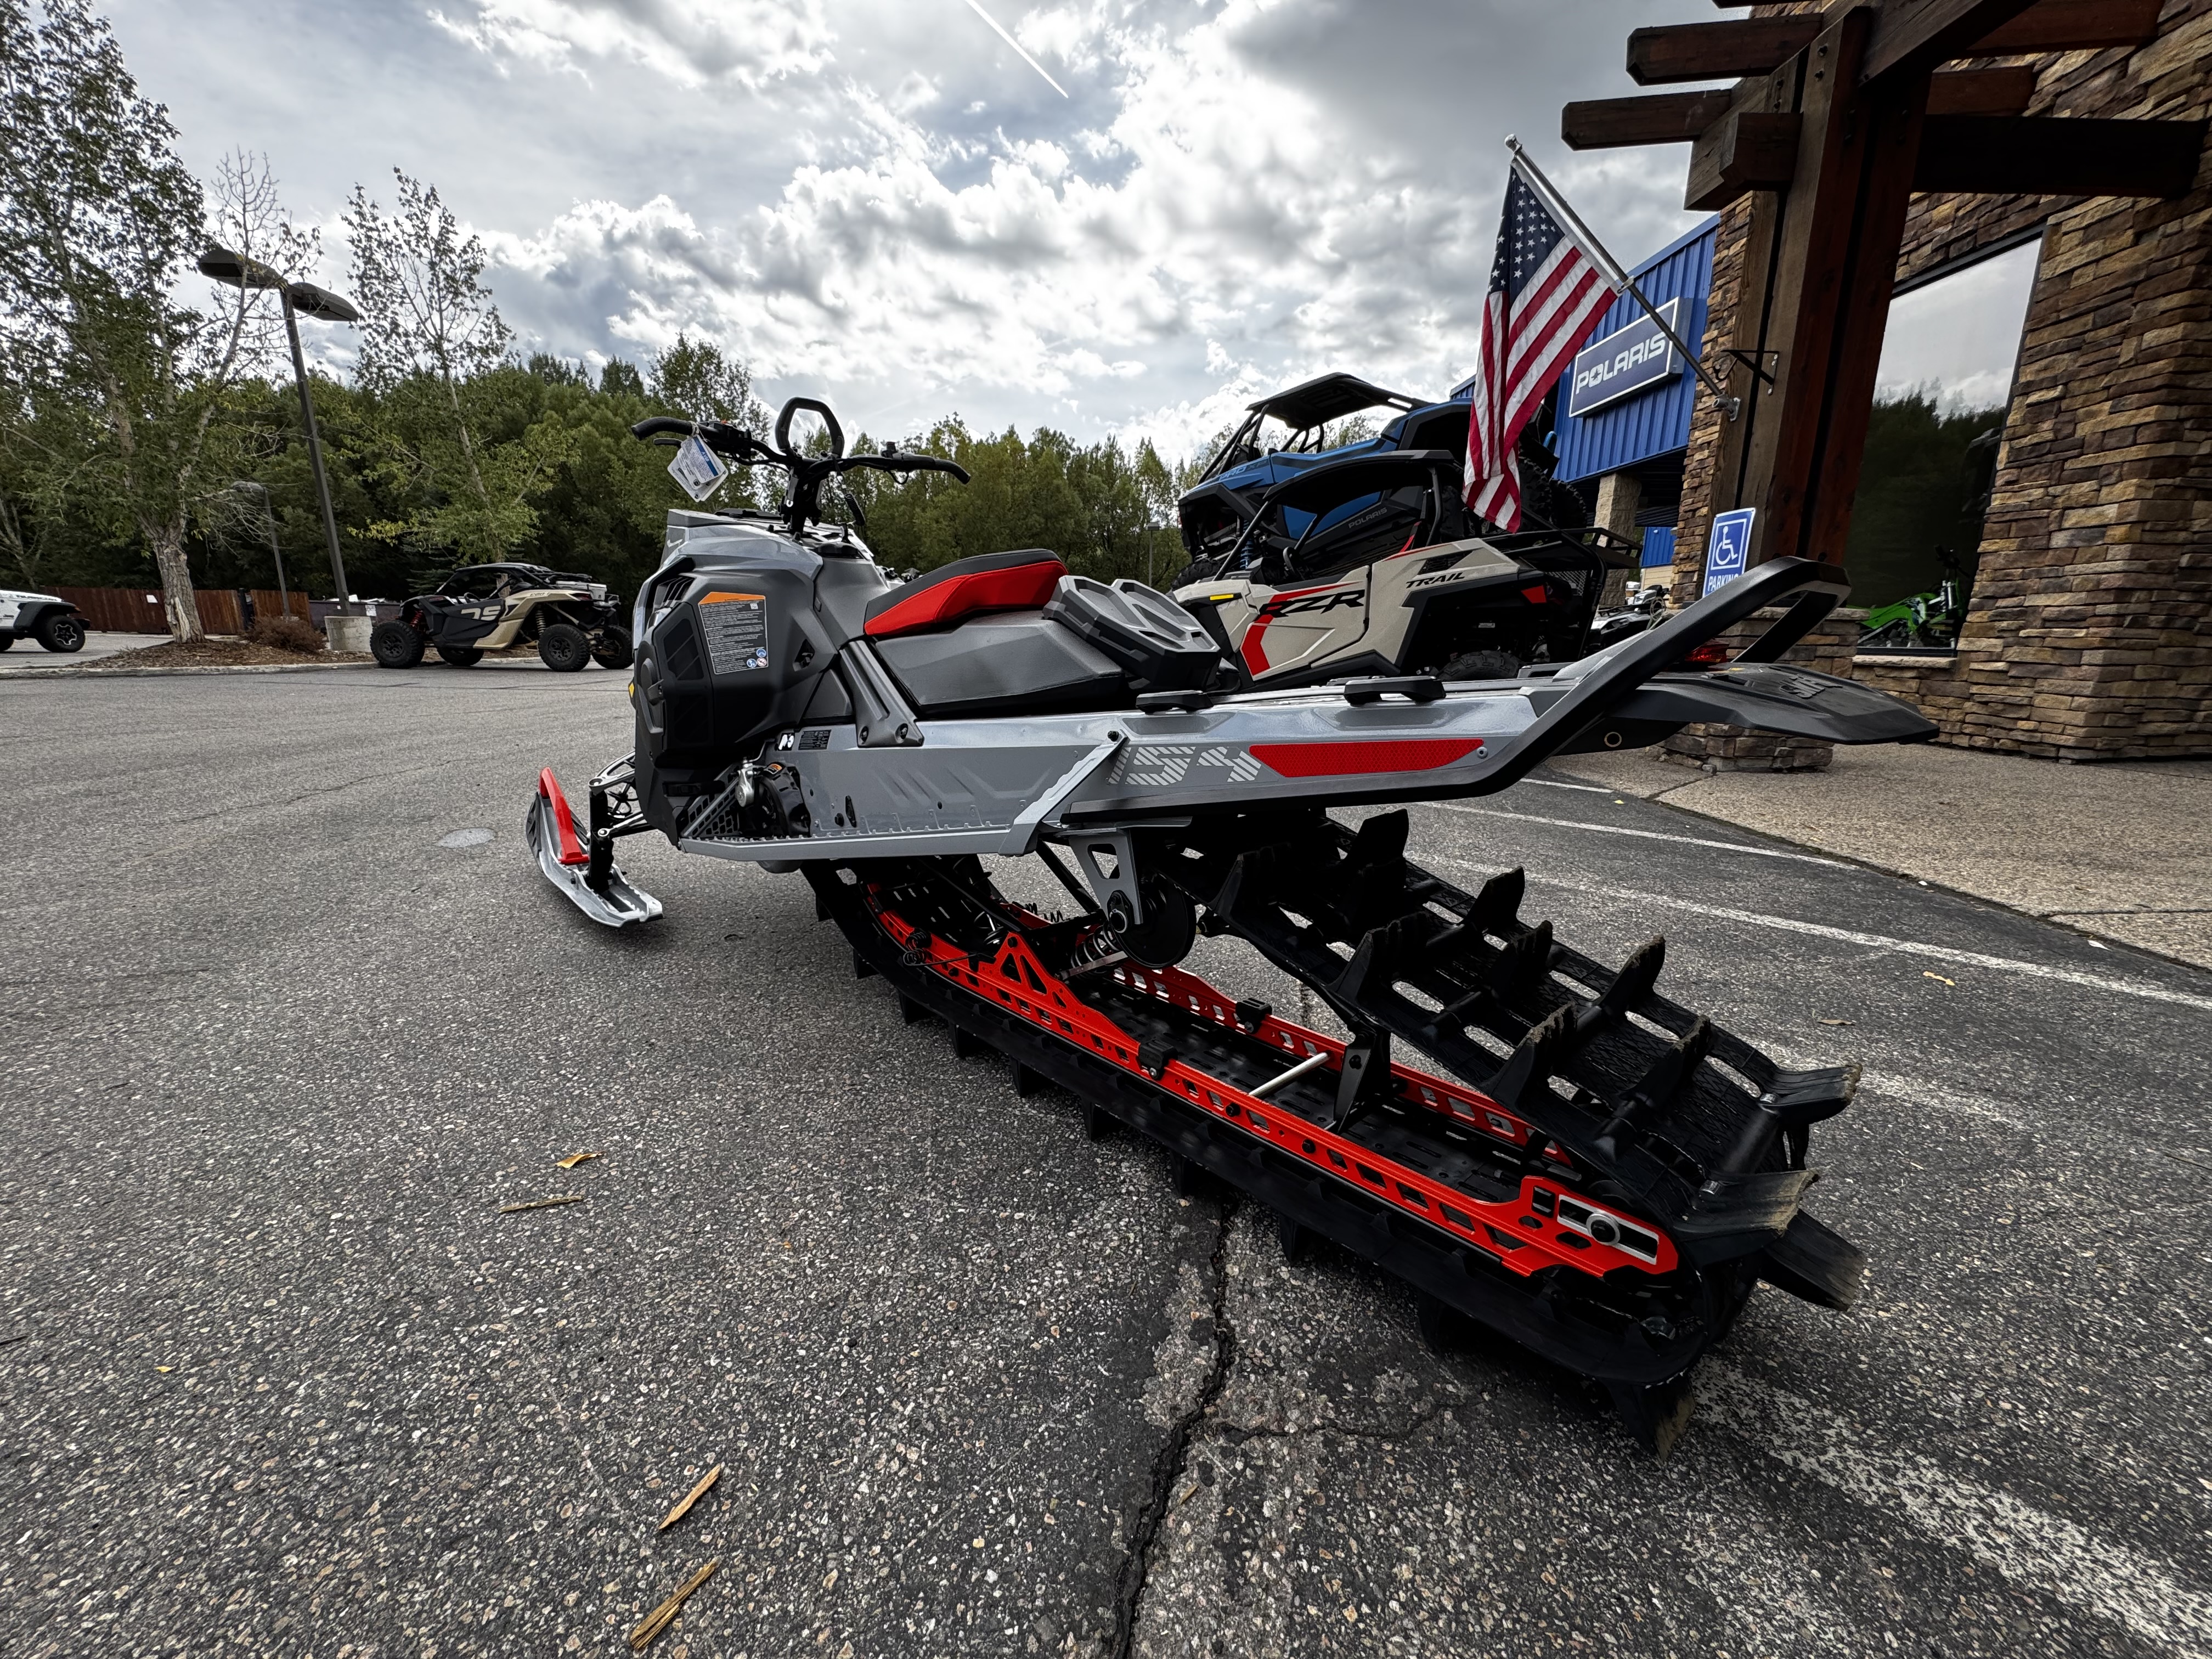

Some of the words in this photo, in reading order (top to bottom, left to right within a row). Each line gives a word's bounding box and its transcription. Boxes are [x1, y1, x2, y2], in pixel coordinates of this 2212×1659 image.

[1576, 332, 1666, 394] POLARIS
[1348, 507, 1387, 529] POLARIS
[1406, 572, 1466, 589] TRAIL
[1255, 589, 1365, 622] RZR
[1108, 746, 1262, 786] 154
